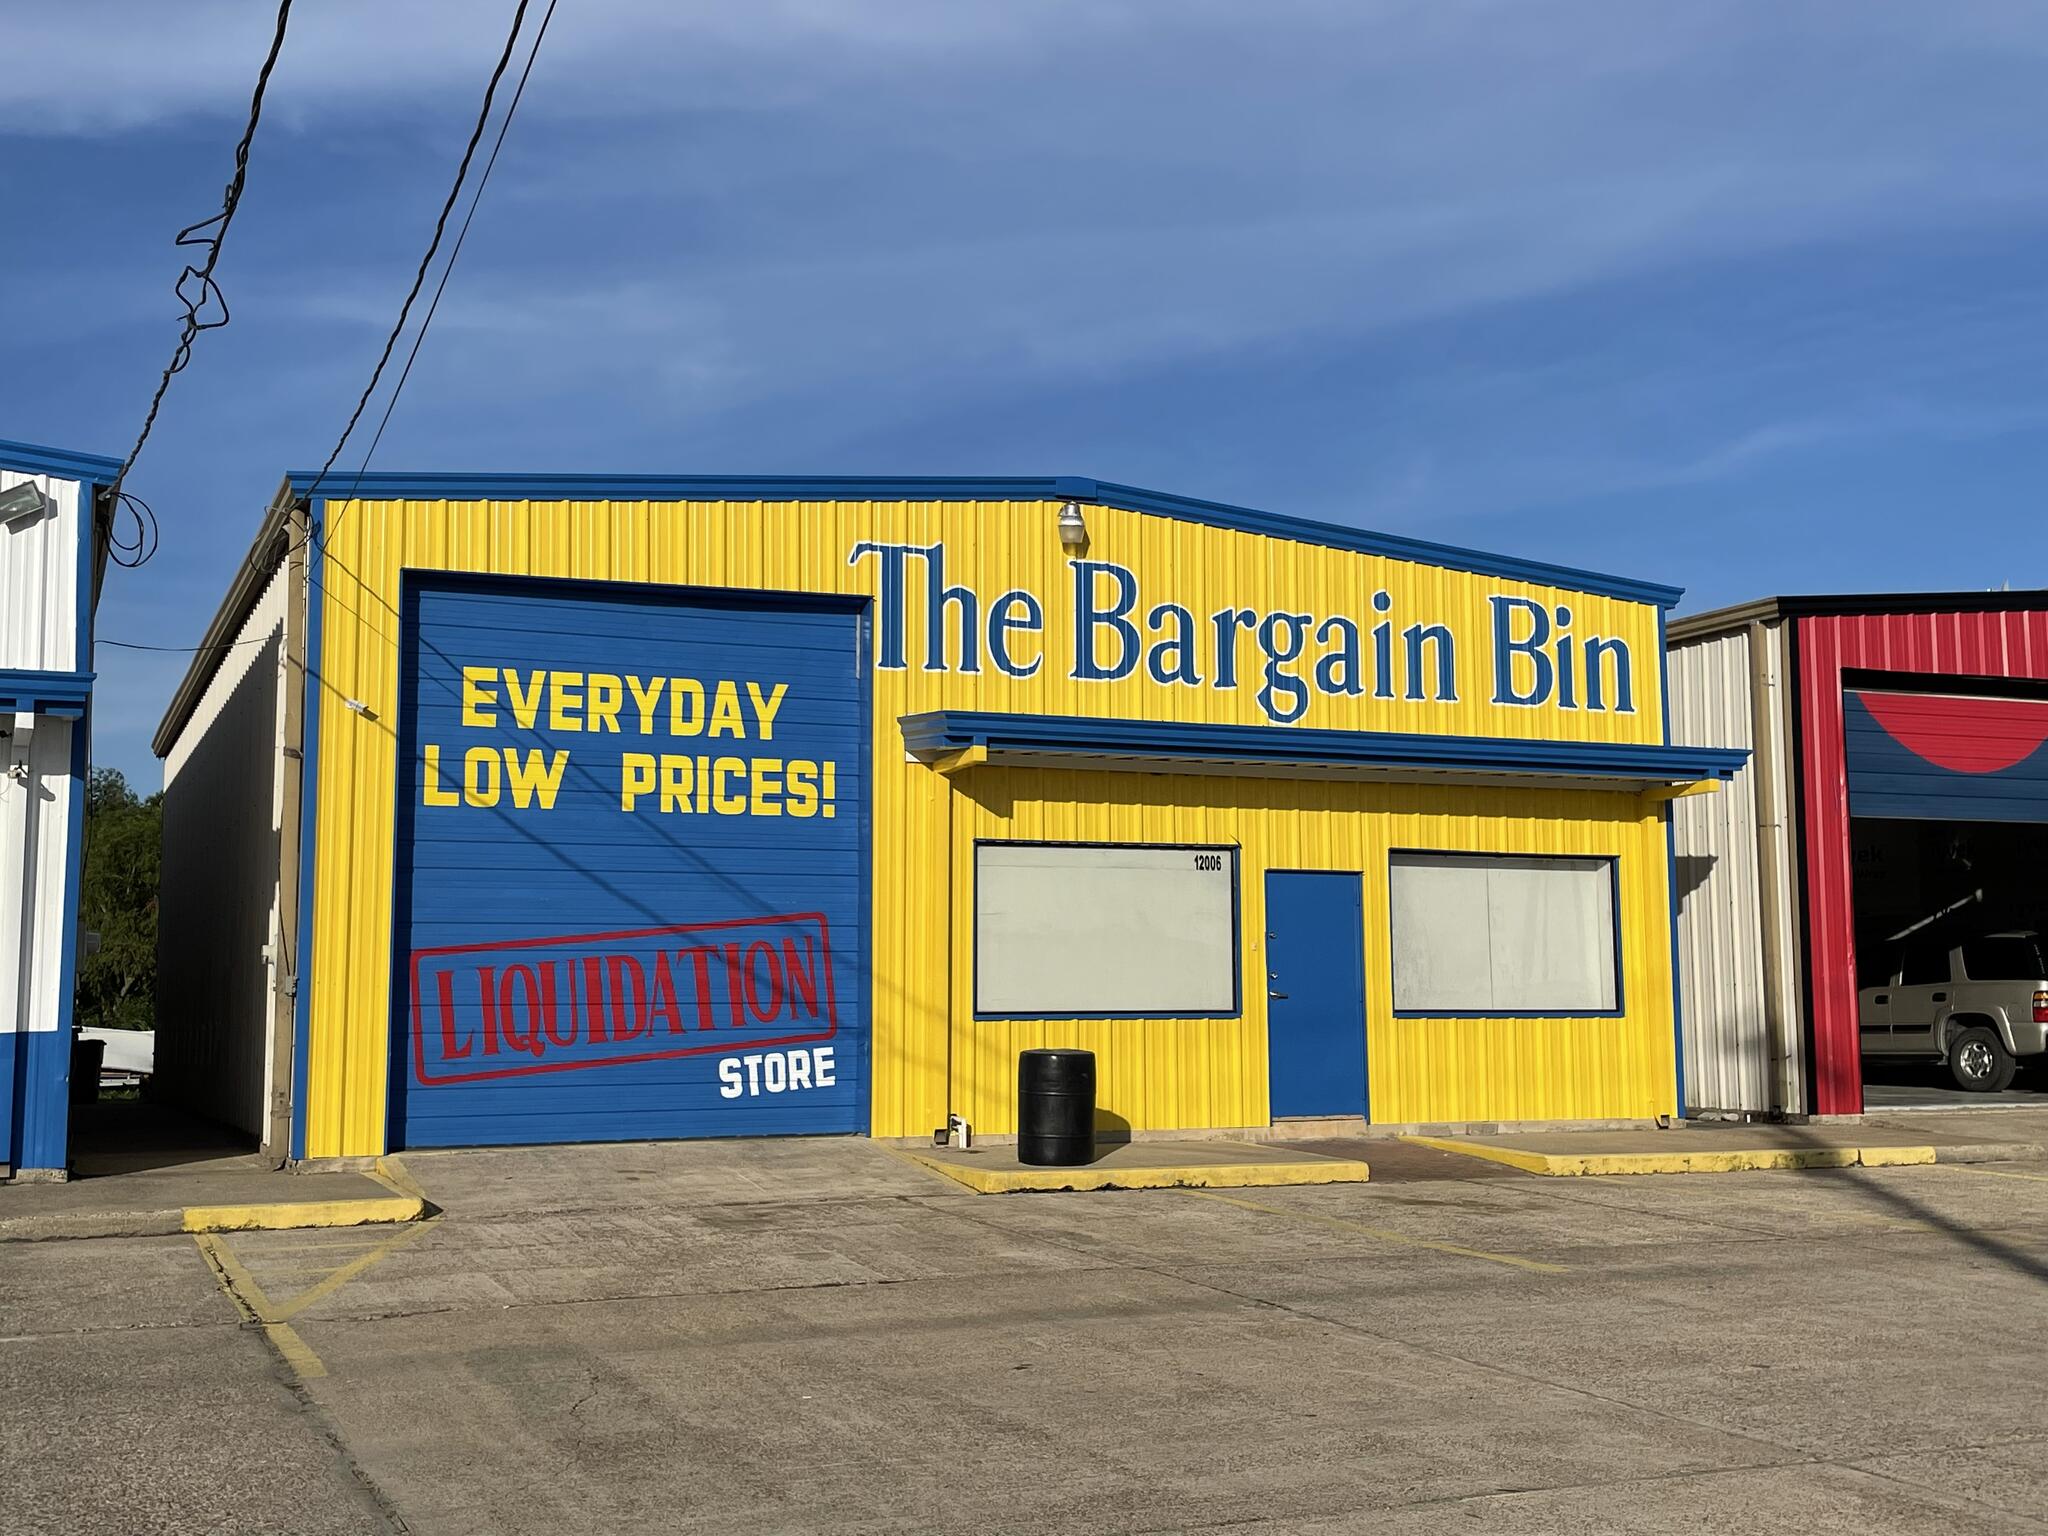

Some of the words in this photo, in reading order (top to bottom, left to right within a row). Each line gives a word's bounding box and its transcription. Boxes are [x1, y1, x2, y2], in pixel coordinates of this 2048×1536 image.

[849, 541, 1044, 680] The
[1067, 558, 1458, 725] Bargain
[1488, 595, 1636, 714] Bin
[461, 665, 790, 741] EVERYDAY
[423, 744, 570, 809] LOW
[621, 752, 836, 818] PRICES!
[1193, 854, 1222, 871] 12006
[435, 935, 820, 1061] LIQUIDATION
[718, 1047, 836, 1099] STORE
